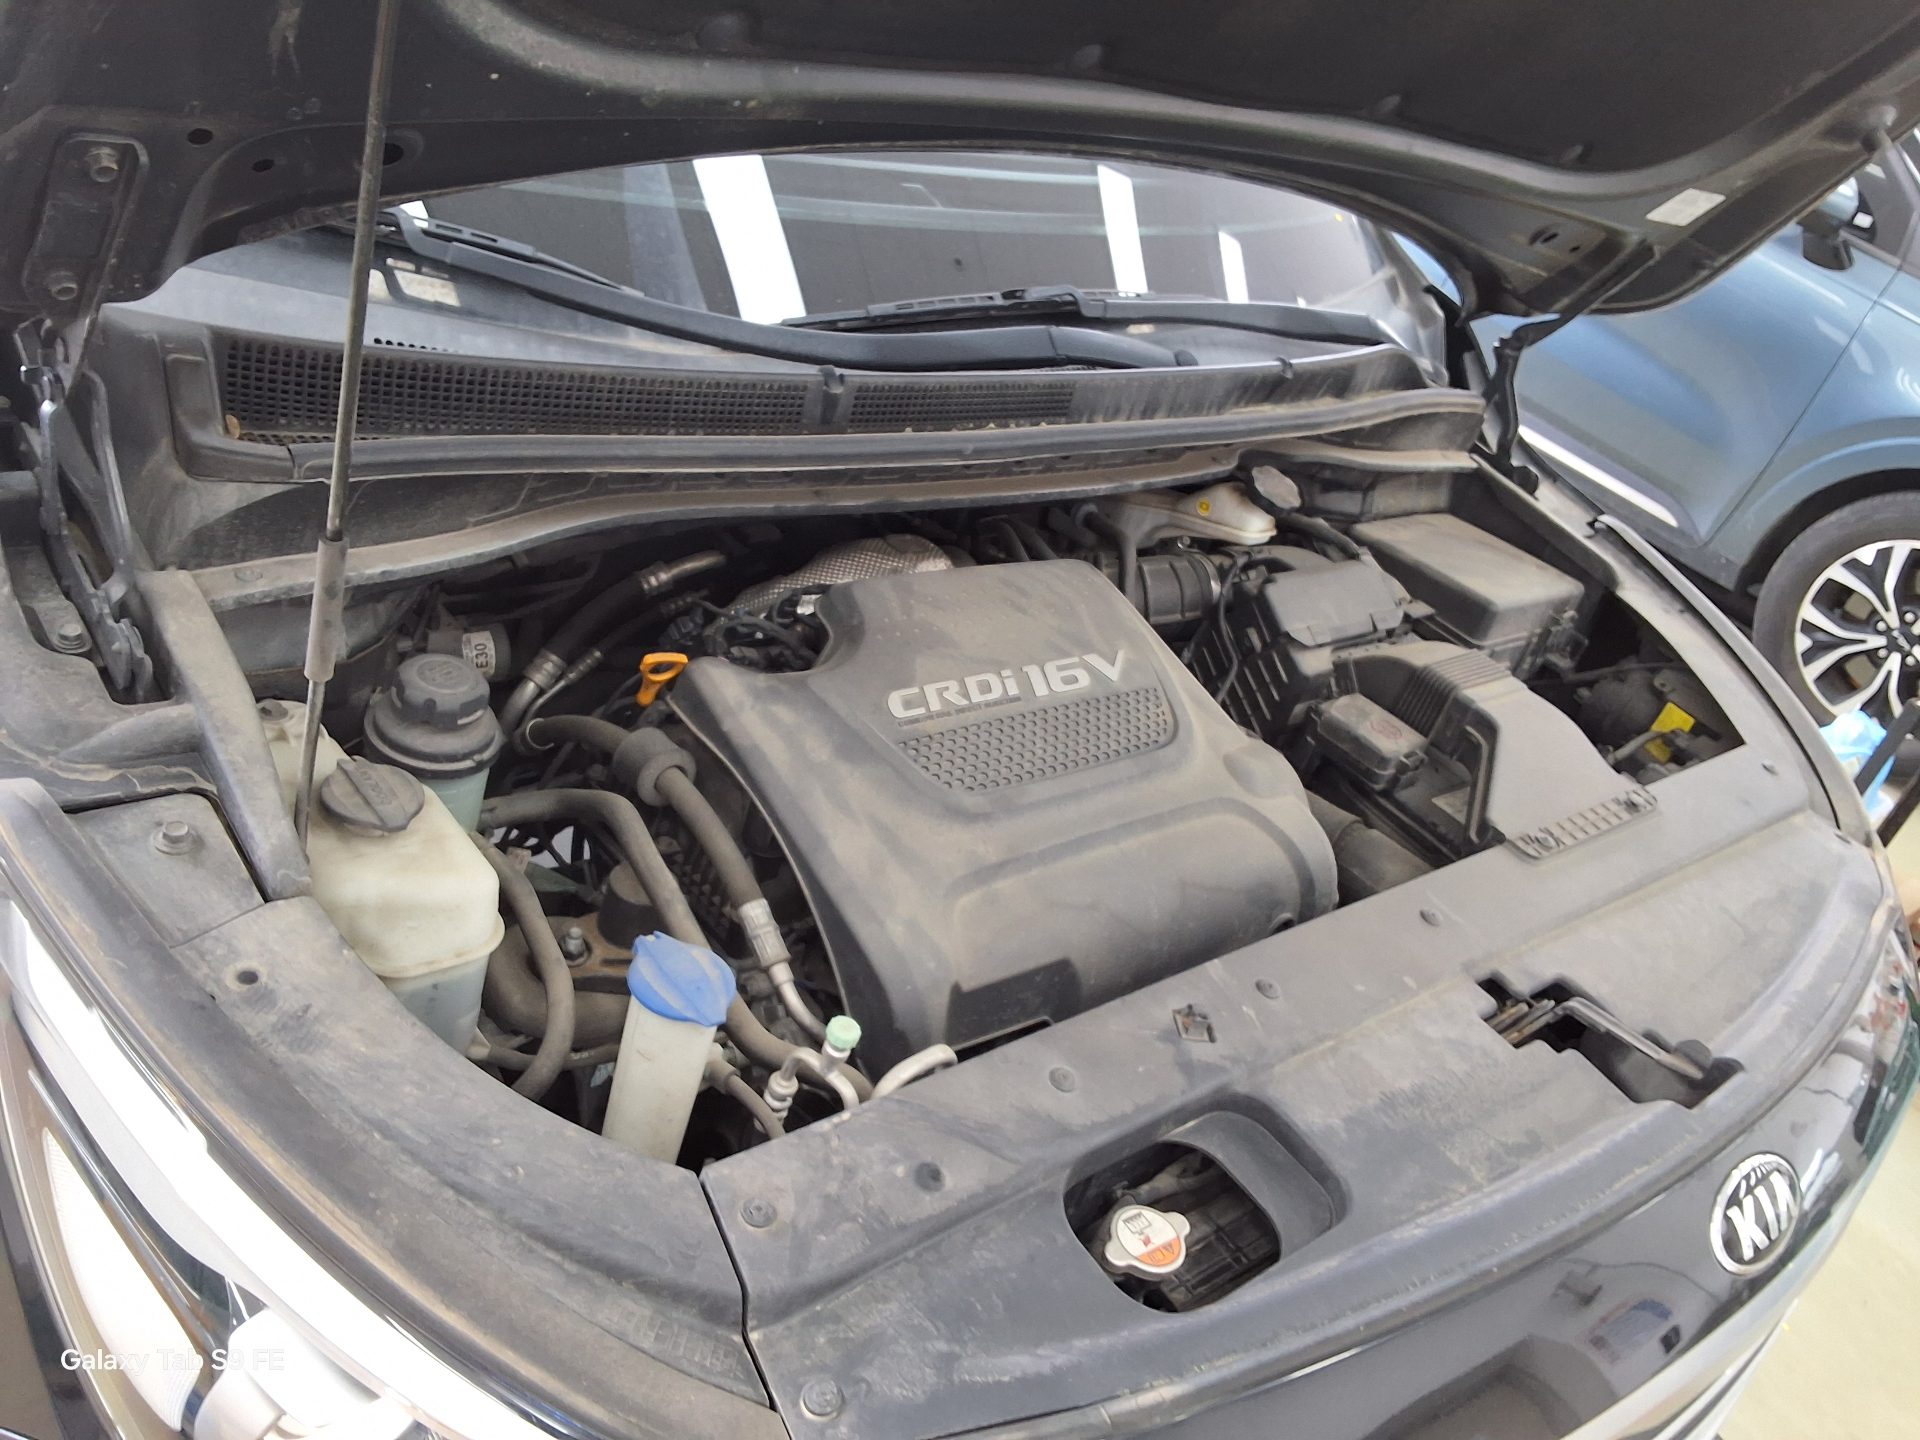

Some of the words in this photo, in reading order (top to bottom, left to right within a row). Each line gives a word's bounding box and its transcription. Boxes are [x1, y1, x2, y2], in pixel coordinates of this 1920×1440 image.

[474, 643, 488, 669] E30
[887, 669, 1020, 718] CRDi
[1021, 650, 1125, 698] 16V
[1726, 1170, 1797, 1261] KIA
